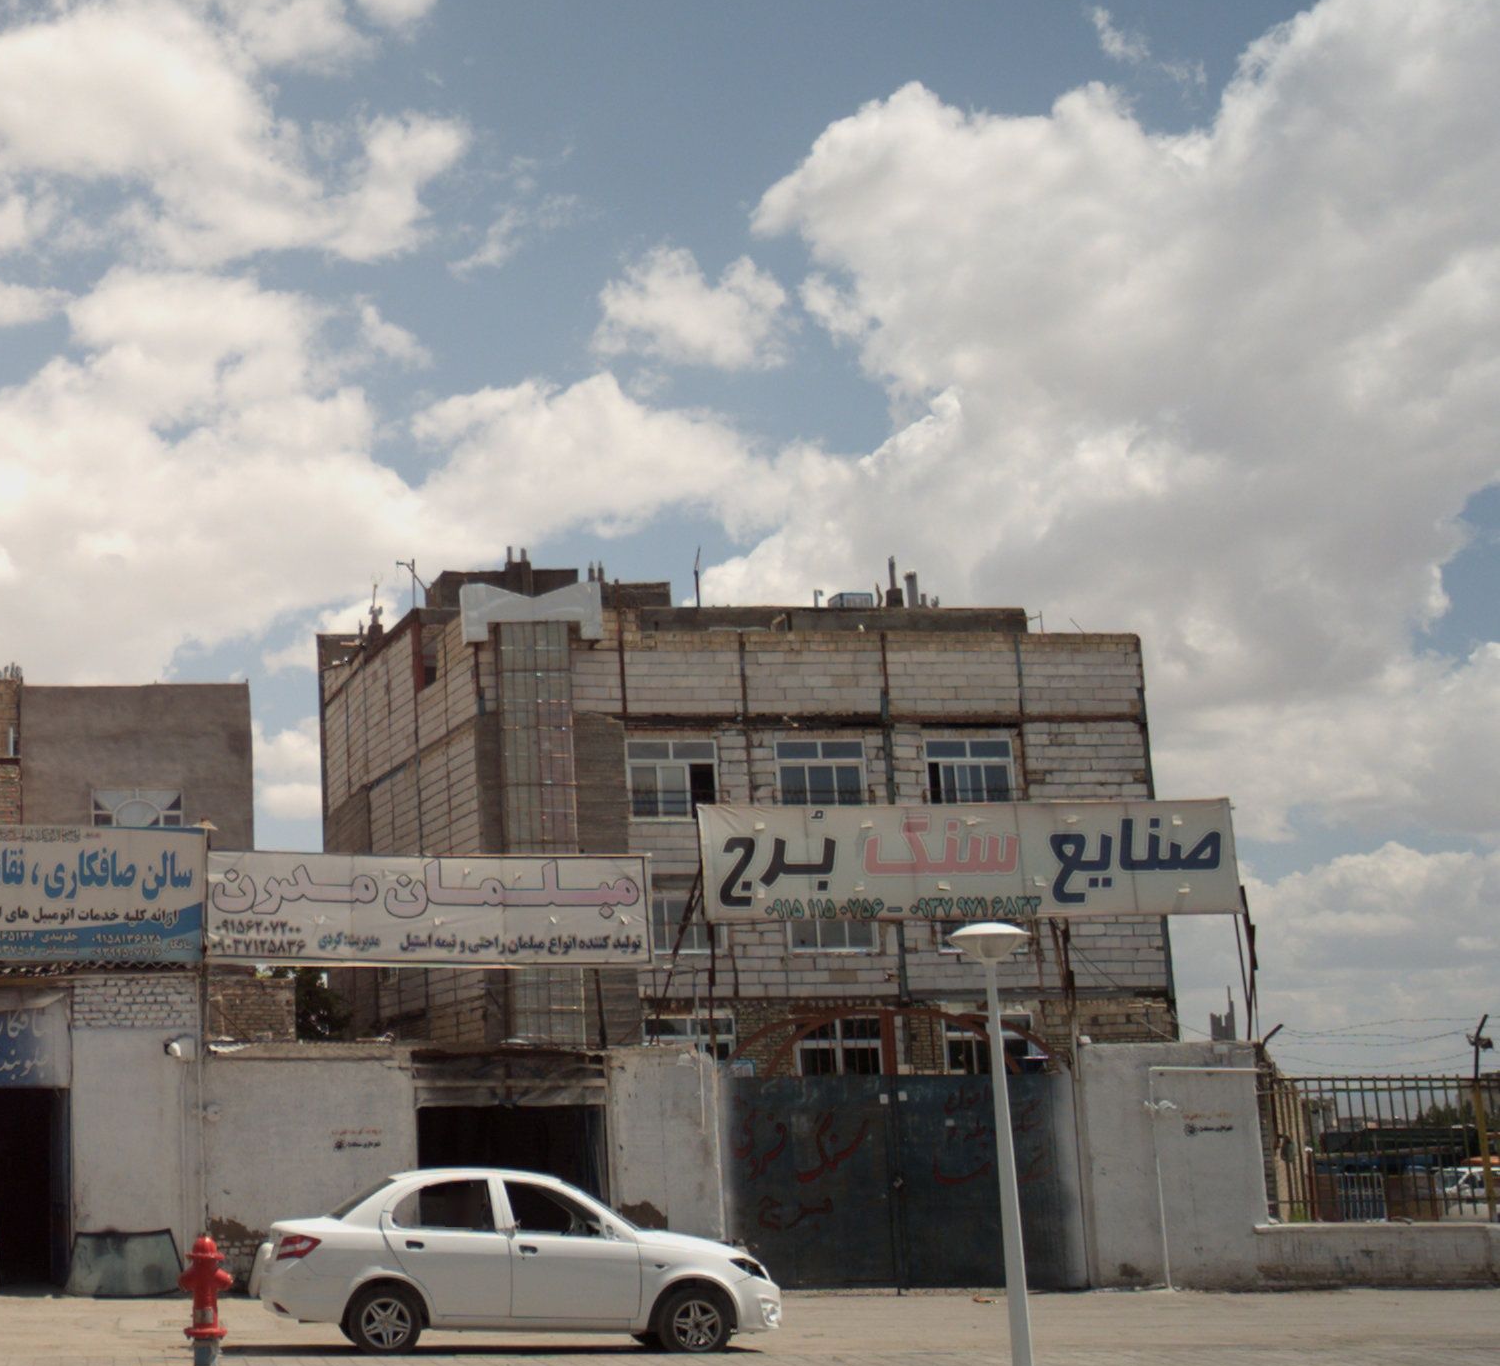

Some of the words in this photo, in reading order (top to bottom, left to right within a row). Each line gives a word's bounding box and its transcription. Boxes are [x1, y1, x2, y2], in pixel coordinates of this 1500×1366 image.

[863, 816, 1019, 875] سنگ
[1048, 816, 1222, 905] صنایع
[142, 849, 193, 901] سالن
[211, 863, 379, 915] مدرن
[384, 858, 640, 920] مبلمان
[5, 906, 29, 923] های
[33, 907, 75, 924] اتومبیل
[78, 907, 119, 923] خدمات
[123, 908, 147, 927] کلیه
[765, 898, 805, 920] ۰۹۱۵
[808, 898, 837, 920] ۱۱۵
[839, 897, 884, 920] ۰۷۵۶
[909, 897, 954, 919] ۰۹۳۷
[957, 896, 989, 918] ۹۷۱
[401, 933, 433, 952] استیل
[434, 934, 457, 953] نیمه
[460, 940, 466, 953] و
[467, 934, 506, 954] راحتی
[507, 935, 545, 954] مبلمان
[547, 935, 577, 954] انواع
[578, 934, 610, 951] کننده
[612, 934, 642, 955] تولید
